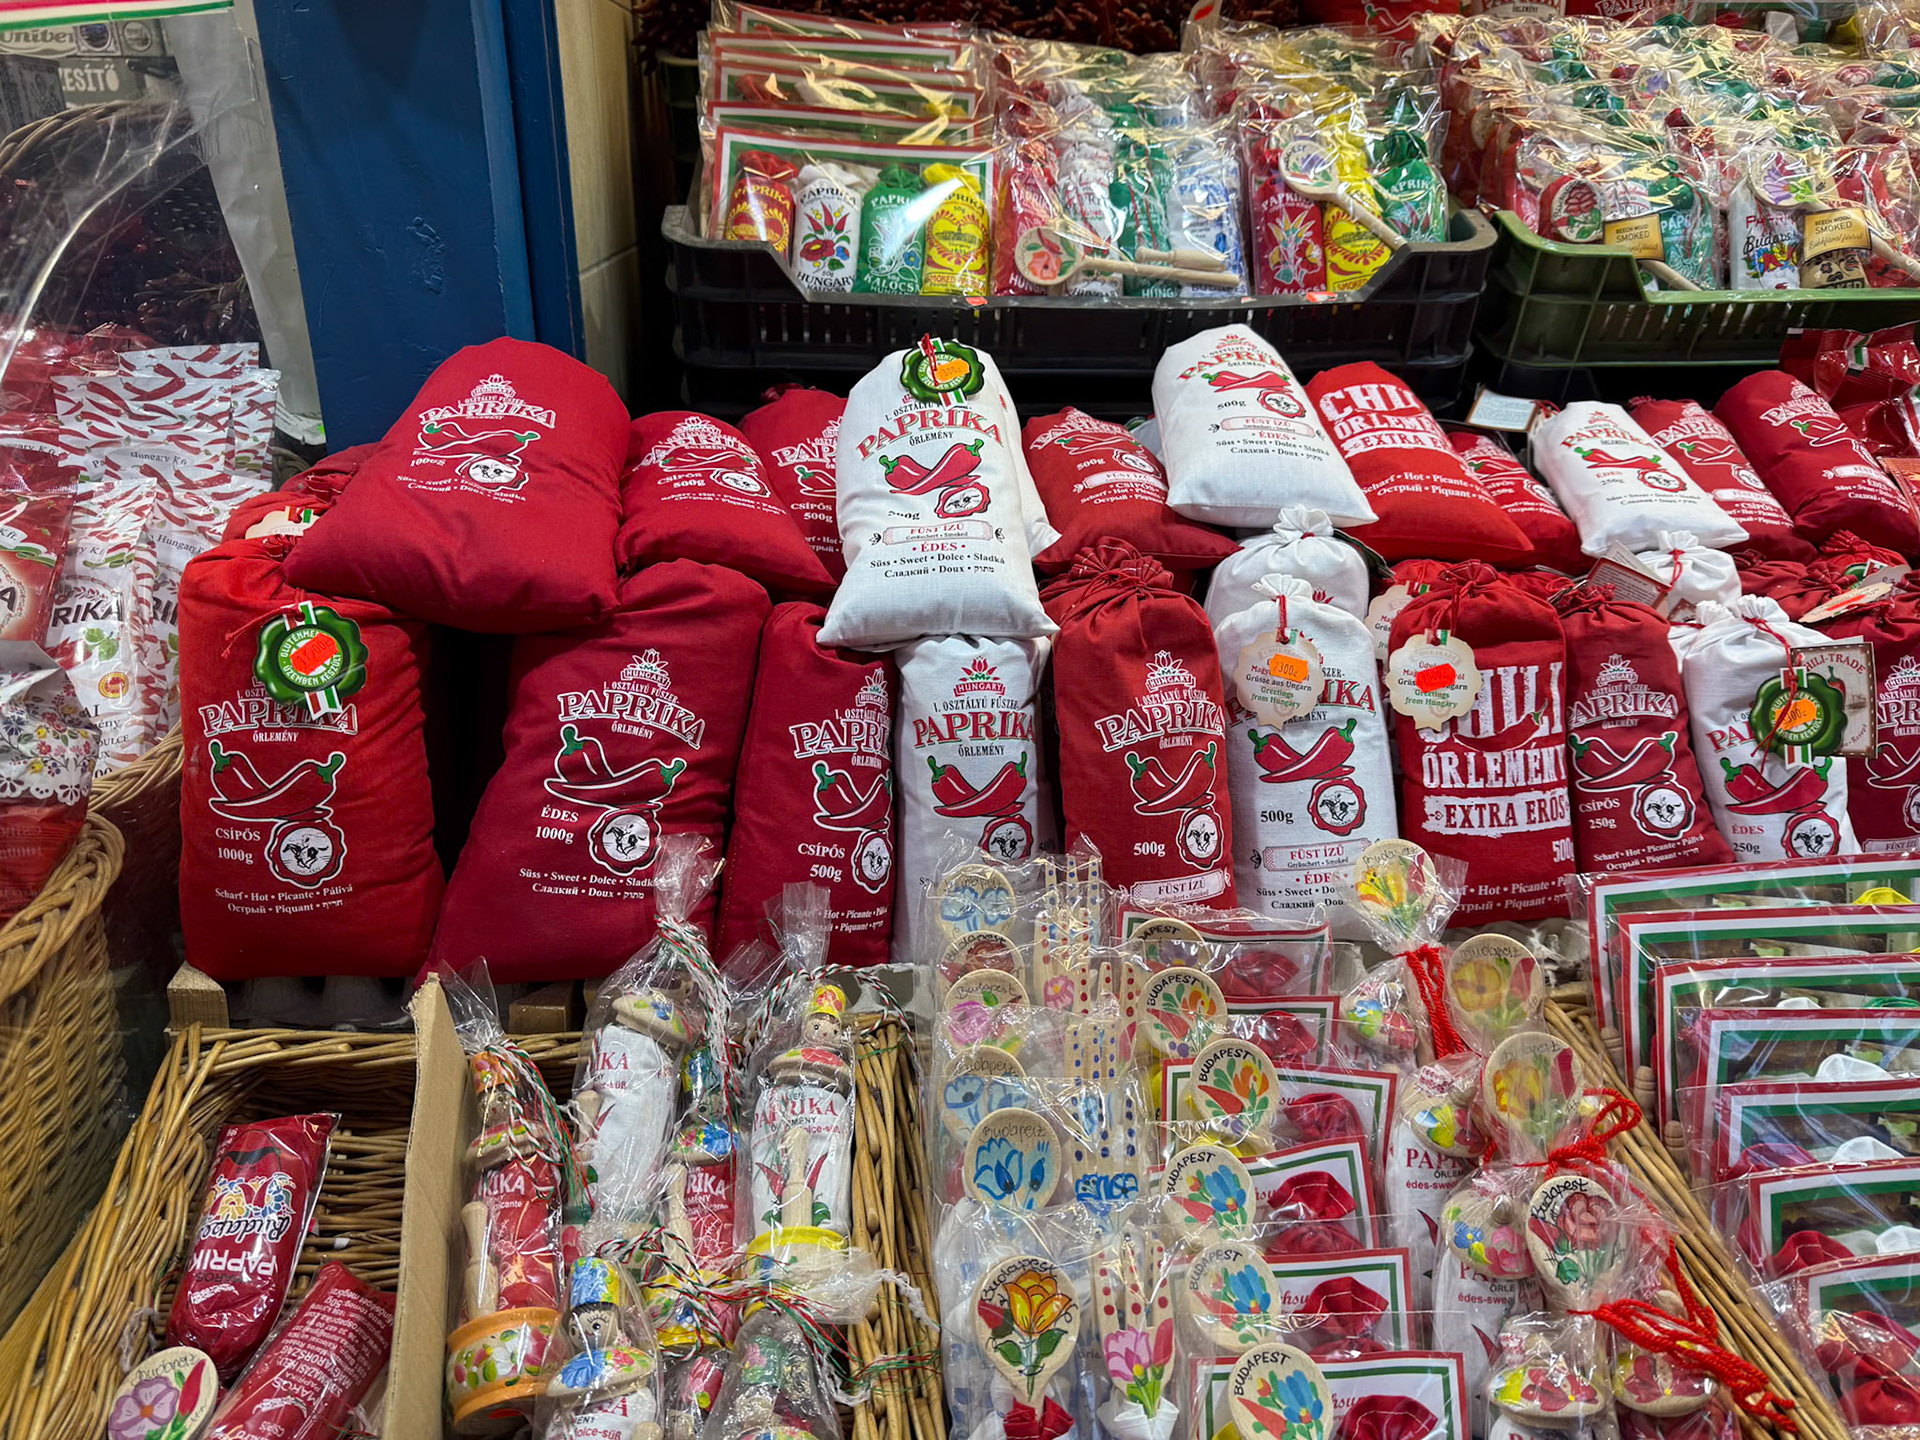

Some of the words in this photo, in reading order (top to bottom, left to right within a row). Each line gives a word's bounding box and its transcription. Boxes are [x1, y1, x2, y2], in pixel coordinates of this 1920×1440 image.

[1815, 220, 1853, 235] SMOKED
[1616, 230, 1650, 243] SMOKED
[1217, 400, 1247, 411] 500g
[418, 401, 556, 429] PAPRIKA
[855, 407, 1005, 461] PAPRIKA
[908, 431, 954, 447] ŐRLEMÉNY
[1258, 430, 1290, 441] ÉDES
[1361, 433, 1422, 446] EXTRA
[1242, 438, 1267, 447] Sweet
[1274, 440, 1296, 449] Dolce
[1076, 457, 1106, 471] 500g
[673, 480, 706, 489] 500g
[1112, 486, 1128, 496] Hot
[1362, 474, 1397, 494] Scharf
[1403, 472, 1425, 481] Hot
[1432, 474, 1469, 488] Picante
[1376, 484, 1423, 497] Острый
[1430, 485, 1470, 499] Piquant
[803, 513, 833, 524] 500g
[920, 541, 958, 552] ÉDES
[870, 560, 892, 569] Süss
[899, 555, 929, 566] Sweet
[937, 552, 965, 562] Dolce
[973, 552, 1006, 565] Sladká
[884, 566, 930, 579] Сладкий
[938, 564, 965, 574] Doux
[51, 599, 125, 628] RIKA
[282, 662, 320, 686] ÜZEMBEN
[626, 669, 669, 686] HUNGARY
[1149, 675, 1192, 687] HUNGARY
[957, 682, 1003, 694] HUNGARY
[1245, 673, 1270, 685] Grüsse
[1286, 680, 1312, 692] Ungarn
[611, 680, 649, 694] OSZTÁLYÚ
[651, 686, 680, 705] FŰSZER-
[1142, 689, 1180, 706] OSZTÁLYÚ
[1260, 686, 1294, 699] Greetings
[943, 698, 988, 712] OSZTÁLYÚ
[1251, 693, 1269, 703] from
[1269, 695, 1301, 709] Hungary
[1405, 697, 1424, 706] from
[1424, 698, 1458, 709] Hungary
[198, 697, 358, 737] PAPRIA
[557, 689, 706, 750] PAPRIKA
[611, 722, 655, 739] ŐRLEMÉNY
[912, 710, 1036, 750] PAPRIKA
[1094, 699, 1226, 753] PAPRIKA
[252, 729, 300, 743] ŐRLEMÉNY
[1159, 734, 1193, 750] ŐRLEMÉNY
[958, 742, 1005, 758] ŐRLEMÉNY
[1421, 741, 1567, 789] ŐRLEMÉNY
[540, 804, 579, 823] ÉDES
[1444, 803, 1519, 829] EXTRA
[1525, 791, 1566, 825] ERŐS
[1578, 798, 1621, 814] CSÍPŐS
[1260, 810, 1294, 824] 500g
[1589, 817, 1617, 830] 250g
[214, 827, 261, 842] CSÍPŐS
[535, 826, 574, 844] 1000g
[1731, 825, 1765, 835] ÉDES
[217, 848, 254, 865] 1000g
[797, 842, 846, 859] CSÍPŐS
[1133, 841, 1166, 858] 500g
[1289, 848, 1320, 861] FÜST
[1323, 845, 1345, 857] ÍZŰ
[1593, 851, 1620, 863] Scharf
[1625, 848, 1641, 857] Hot
[1647, 842, 1676, 853] Picante
[1732, 843, 1761, 855] 250g
[1325, 856, 1349, 866] Smoked
[1606, 859, 1641, 872] Острый
[1646, 853, 1677, 865] Piquant
[519, 868, 541, 879] Süss
[550, 871, 580, 883] Sweet
[589, 874, 617, 886] Dolce
[809, 864, 843, 882] 500g
[1304, 871, 1340, 885] ÉDES
[215, 887, 243, 900] Scharf
[250, 891, 269, 902] Hot
[277, 889, 314, 901] Picante
[322, 881, 354, 896] Pálivá
[532, 882, 578, 895] Сладкий
[588, 886, 614, 898] Doux
[1158, 881, 1186, 895] FÜST
[1189, 876, 1206, 891] ÍZŰ
[1256, 887, 1276, 897] Süss
[1284, 886, 1313, 896] Sweet
[1478, 884, 1501, 896] Hot
[1510, 880, 1550, 894] Picante
[227, 903, 267, 915] Острый
[275, 903, 314, 915] Piquant
[1271, 898, 1315, 910] Сладкий
[1503, 896, 1546, 911] Piquant
[823, 909, 840, 919] Hot
[846, 910, 872, 919] Picante
[955, 982, 1018, 1000] Budapest
[1146, 973, 1200, 1007] BUDAPEST
[1198, 1047, 1253, 1082] BUDAPEST
[1166, 1151, 1216, 1195] BUDAPEST
[686, 1174, 726, 1201] RIKA
[1530, 1177, 1589, 1220] Budapest
[200, 1216, 291, 1244] Budape
[1189, 1248, 1243, 1291] BUDAPEST
[981, 1257, 1057, 1303] Budapest
[324, 1295, 343, 1307] 50g
[1233, 1351, 1291, 1396] BUDAPEST
